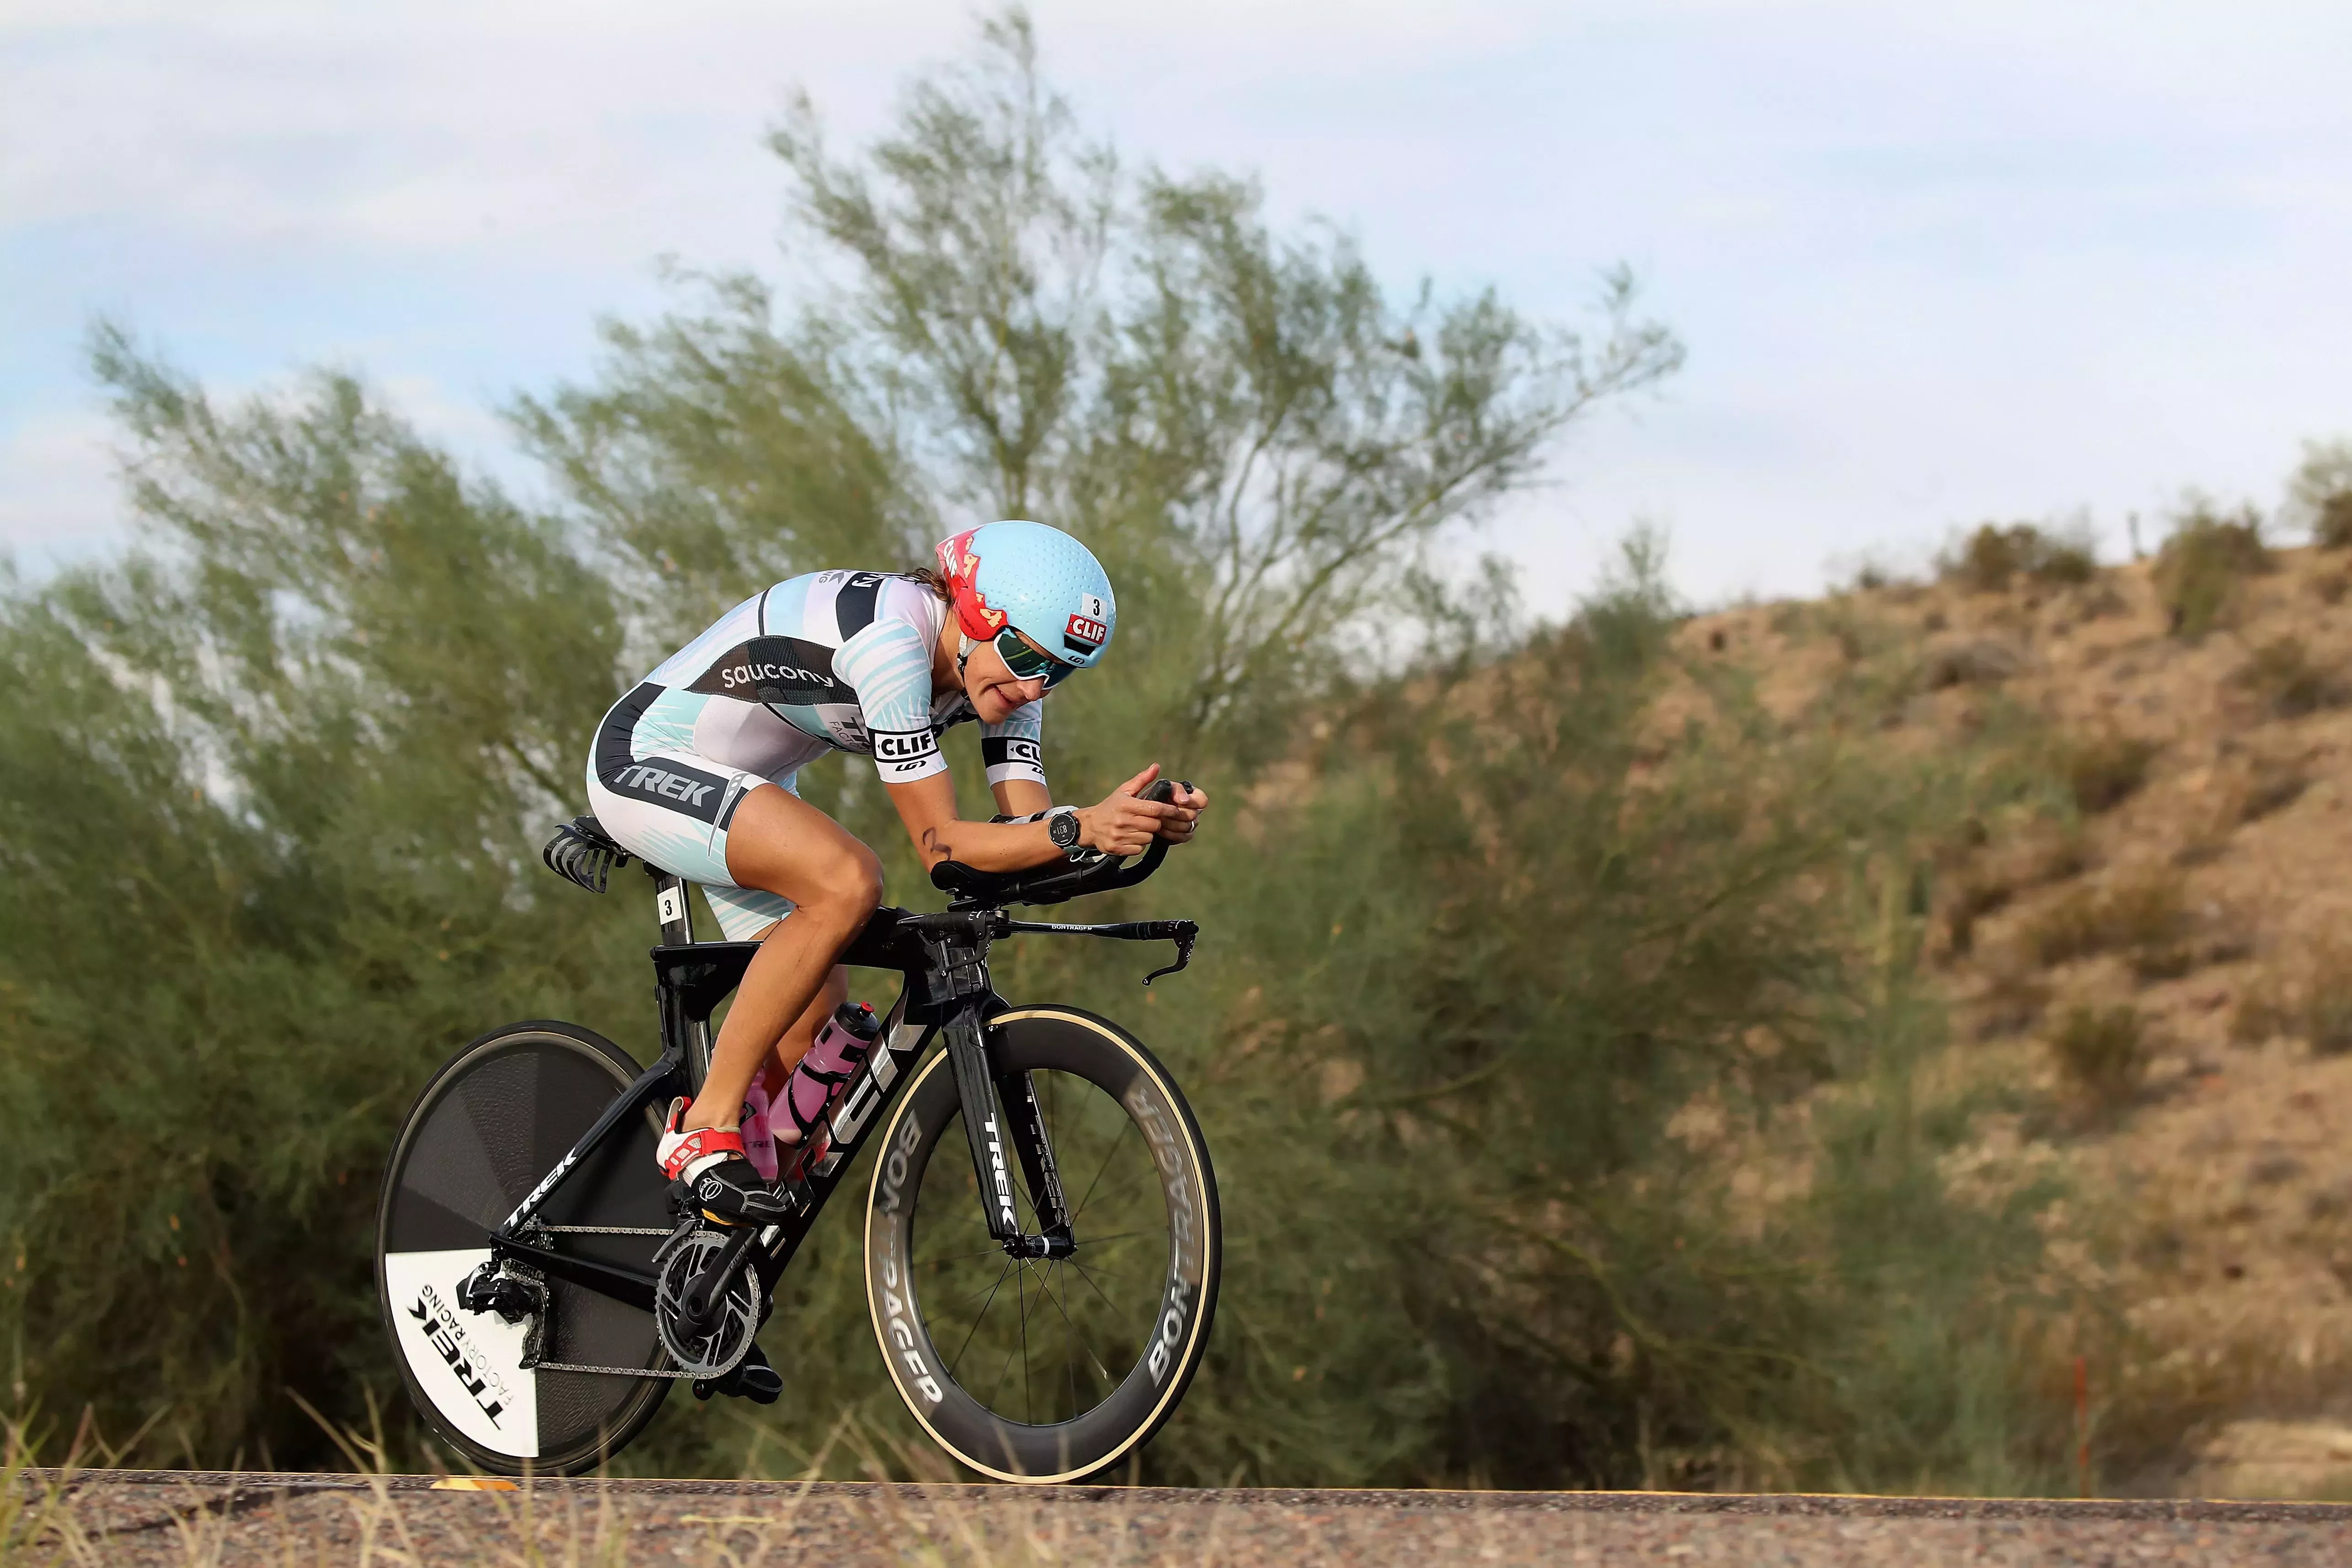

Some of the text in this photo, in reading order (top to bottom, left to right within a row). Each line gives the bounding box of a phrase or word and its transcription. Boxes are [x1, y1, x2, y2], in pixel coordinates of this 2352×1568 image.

[1093, 599, 1100, 616] 3
[1073, 619, 1105, 641] CLIF
[722, 663, 834, 689] saucony
[829, 721, 863, 751] FACTO
[881, 733, 932, 756] CLIF
[1016, 744, 1042, 763] CL
[614, 765, 716, 808] TREK
[664, 899, 672, 916] 3
[984, 1112, 1016, 1227] TREK
[504, 1147, 577, 1227] TREK
[422, 1284, 514, 1406] FACTORY RACING
[406, 1296, 504, 1430] TREK
